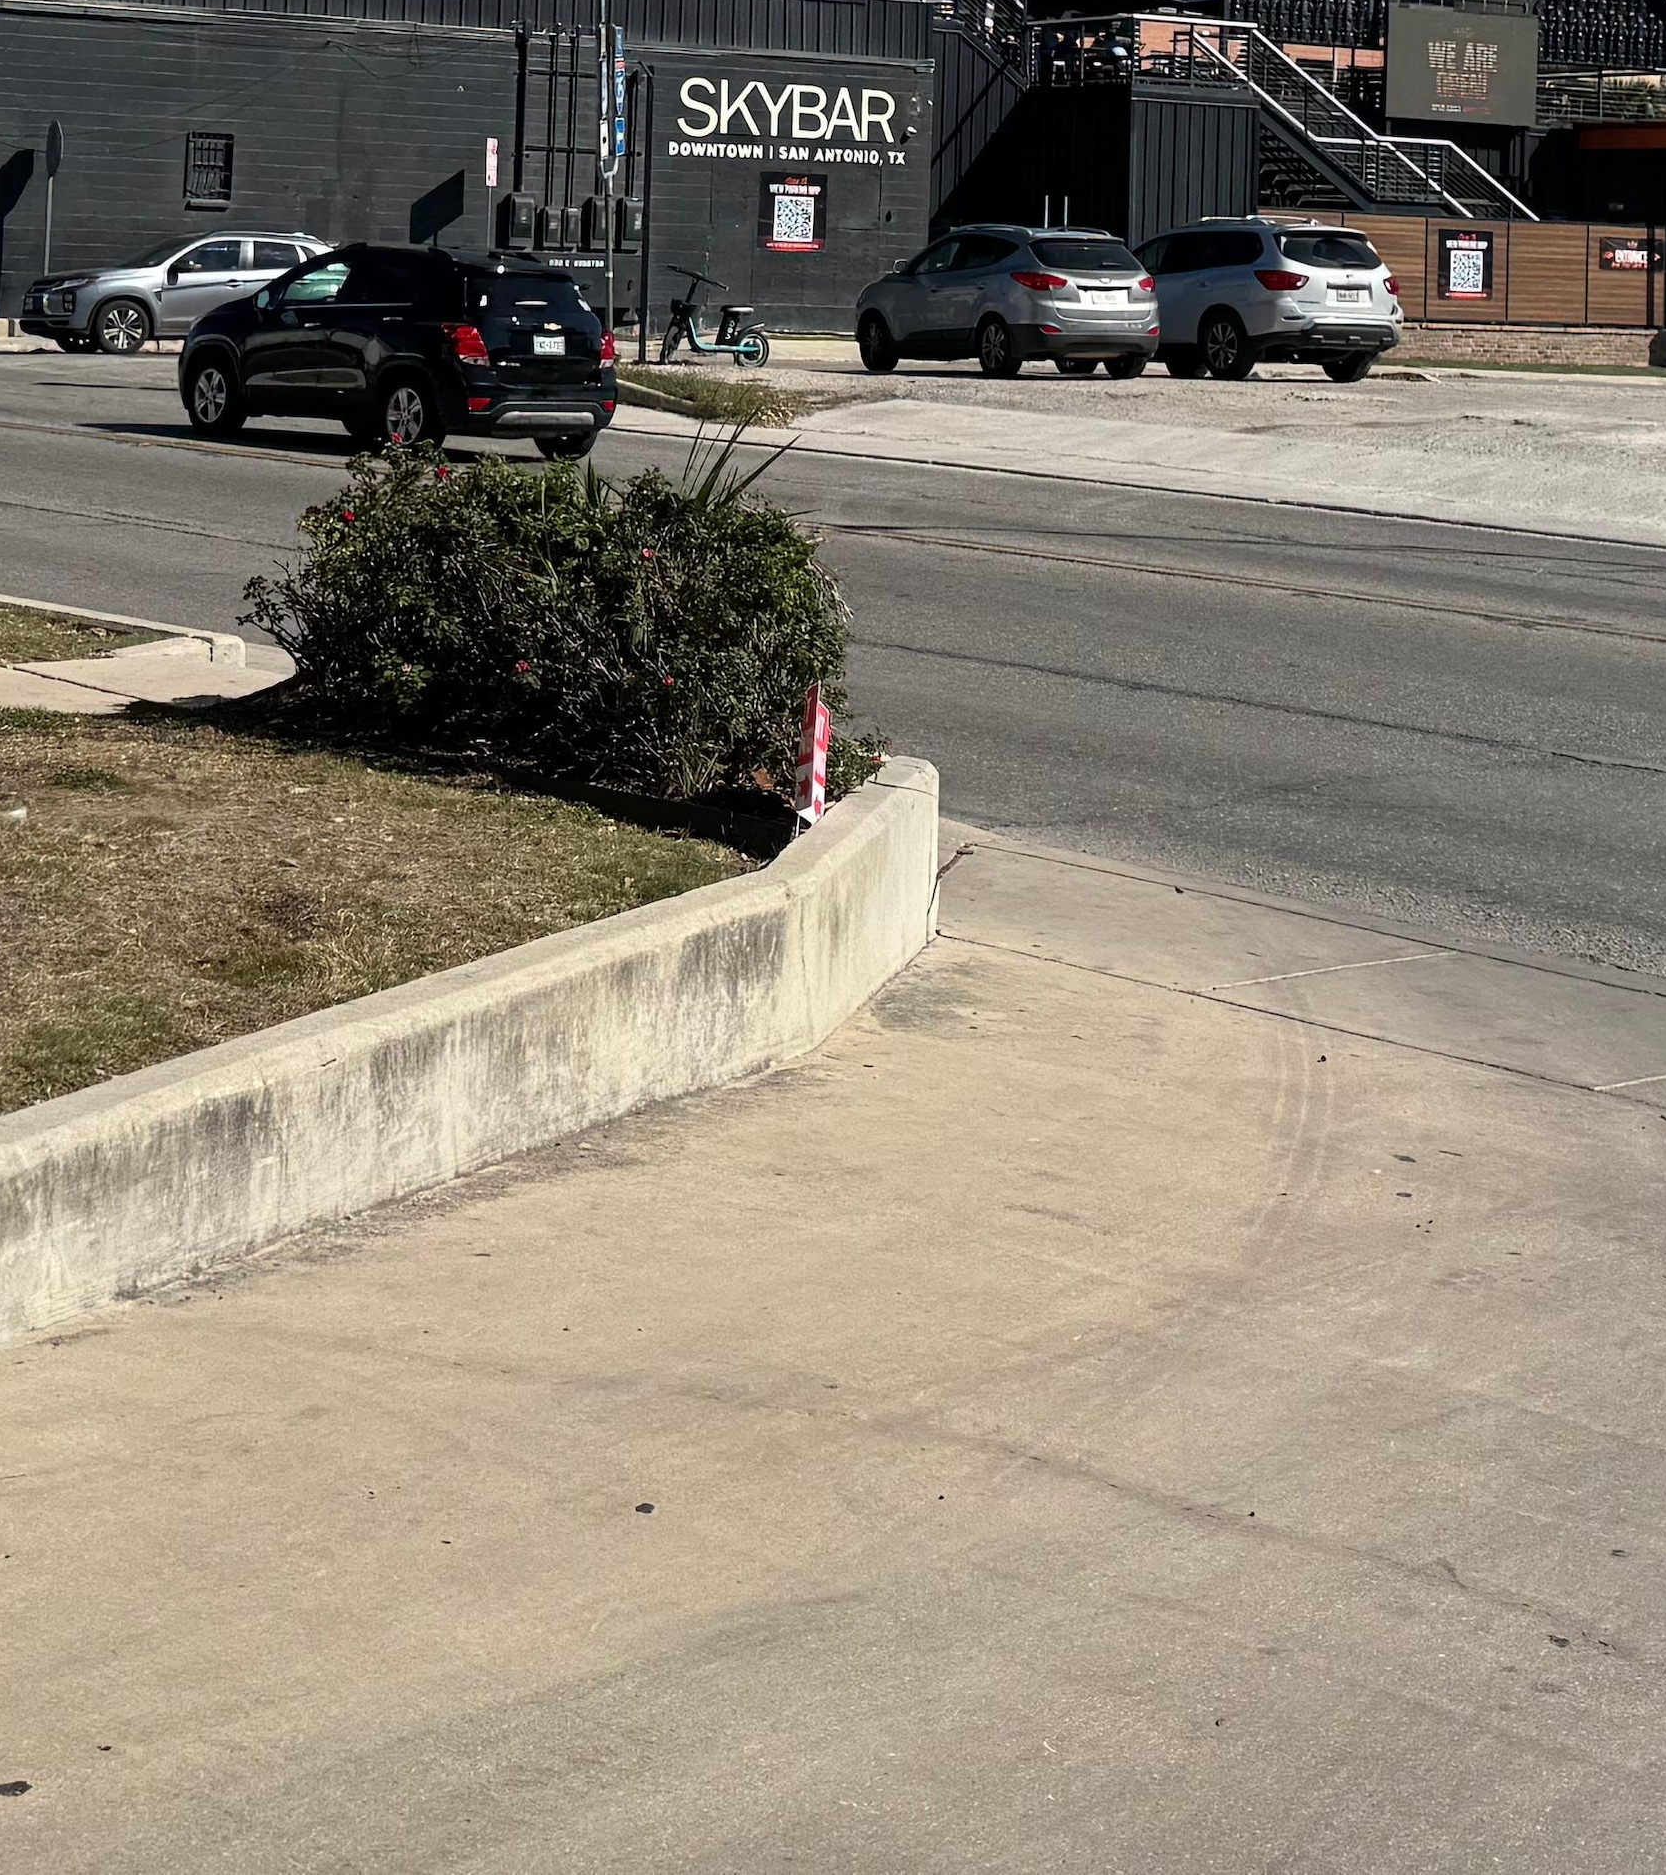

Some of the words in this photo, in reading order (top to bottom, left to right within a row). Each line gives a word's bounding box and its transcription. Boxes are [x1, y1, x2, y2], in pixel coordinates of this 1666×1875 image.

[1428, 40, 1457, 70] WE
[1463, 41, 1498, 73] ARE
[676, 76, 896, 143] SKYBAR
[668, 140, 764, 160] DOWNTOWN
[778, 145, 809, 161] SAN
[813, 147, 884, 167] ANTONIO,
[887, 151, 906, 166] TX
